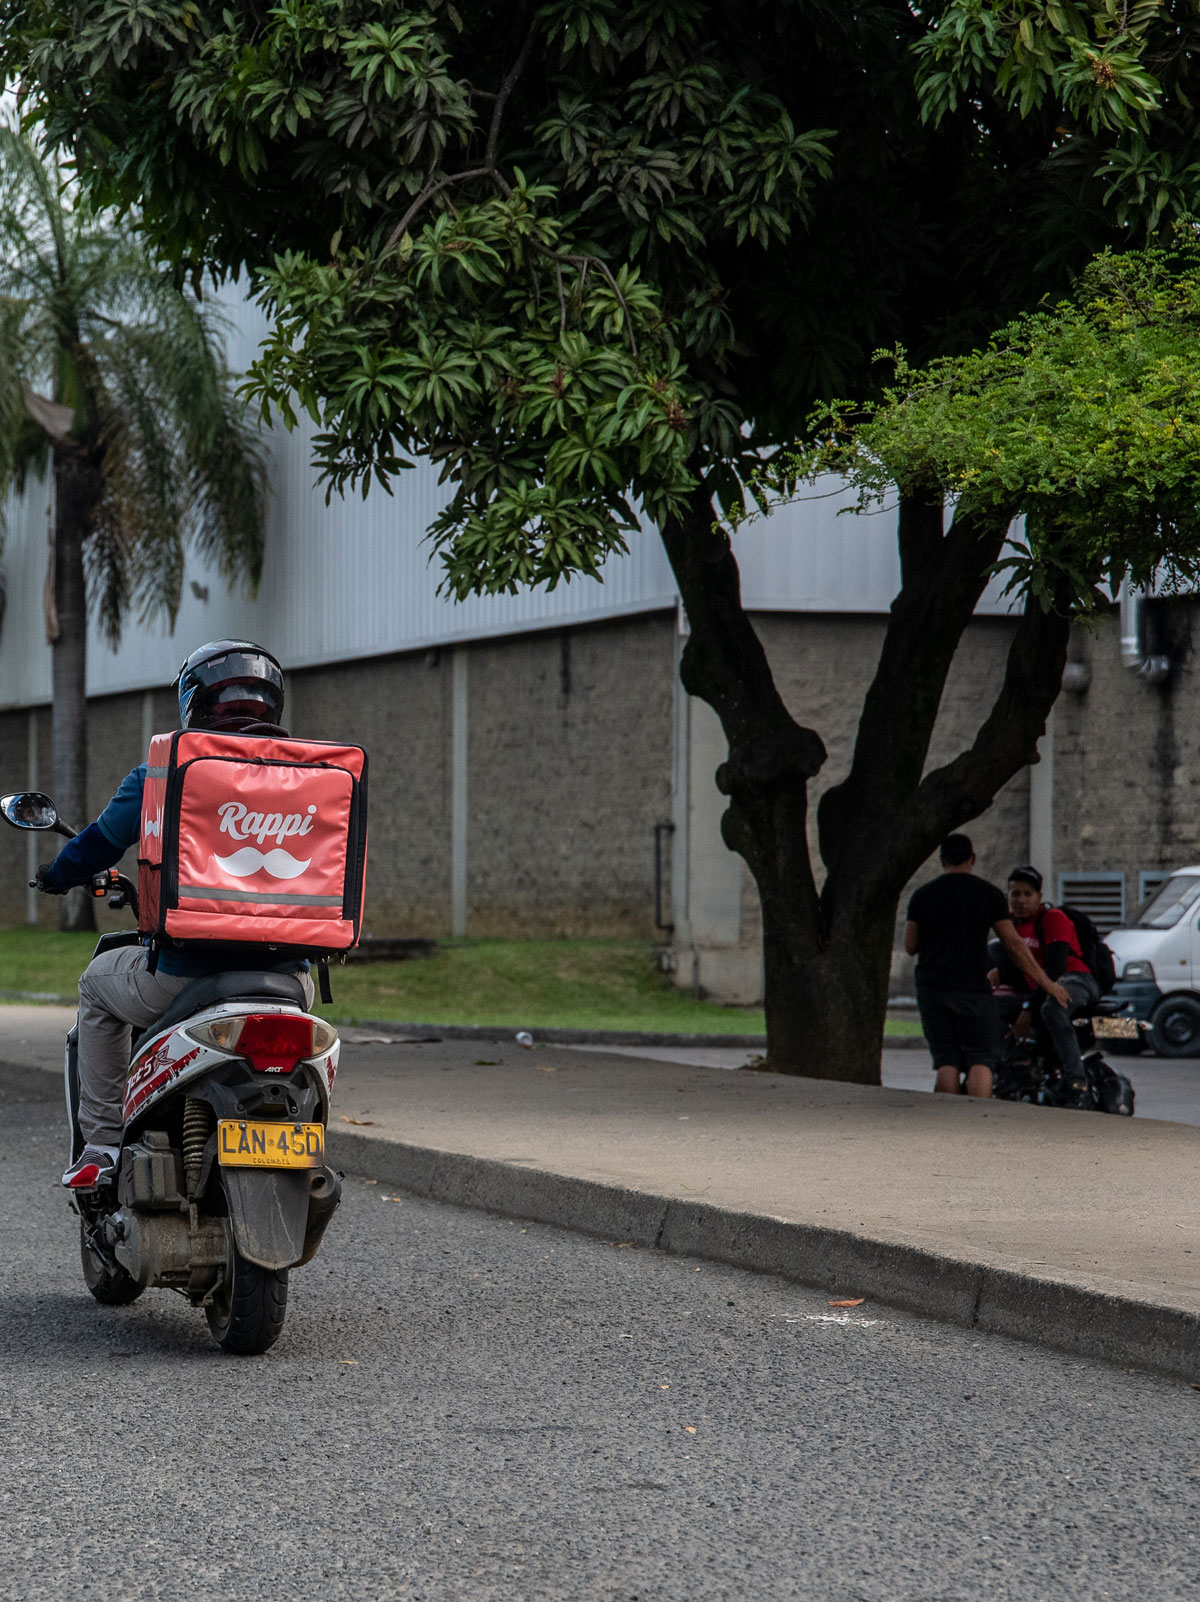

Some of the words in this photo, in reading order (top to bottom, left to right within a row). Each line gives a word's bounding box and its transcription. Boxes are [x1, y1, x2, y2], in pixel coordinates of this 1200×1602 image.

[217, 801, 317, 845] Rappi
[222, 1127, 266, 1154] LAN
[277, 1130, 320, 1157] 45D
